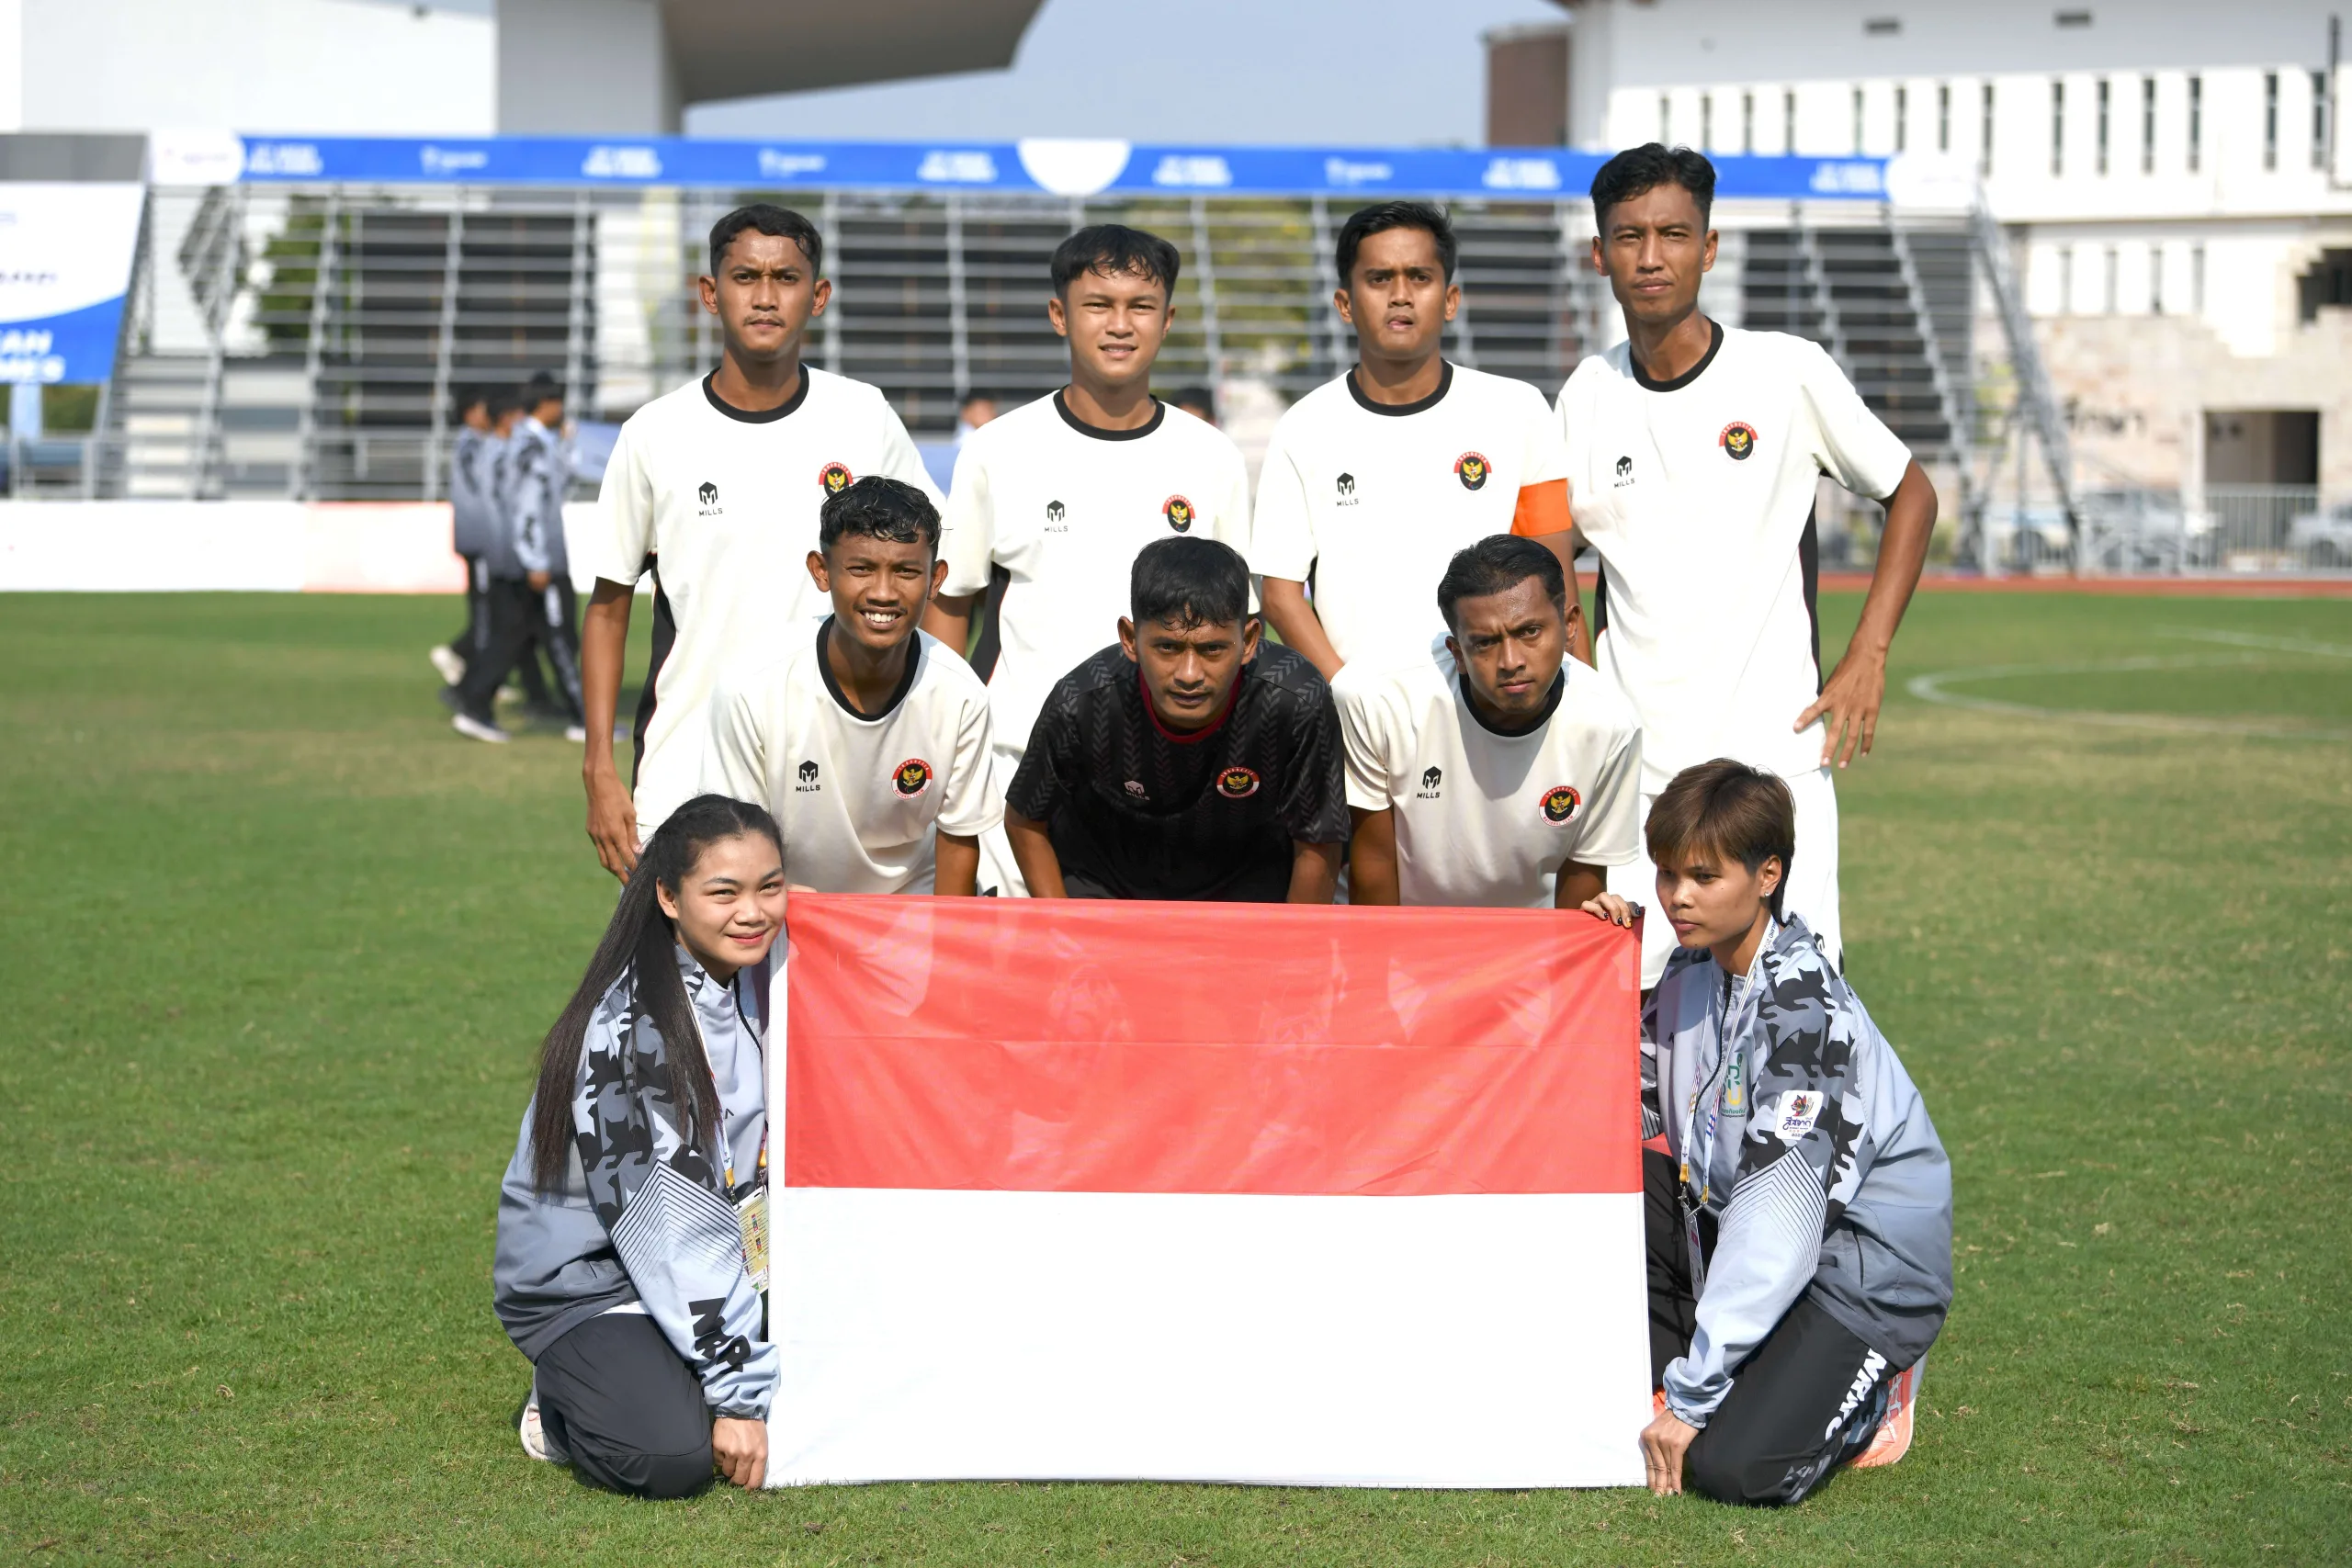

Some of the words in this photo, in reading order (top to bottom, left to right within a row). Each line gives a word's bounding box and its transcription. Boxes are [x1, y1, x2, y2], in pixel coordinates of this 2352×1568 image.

[1613, 478, 1635, 489] MILLS
[1336, 498, 1360, 507] MILLS
[698, 507, 723, 517] MILLS
[796, 784, 820, 793] MILLS
[1416, 791, 1441, 799] MILLS
